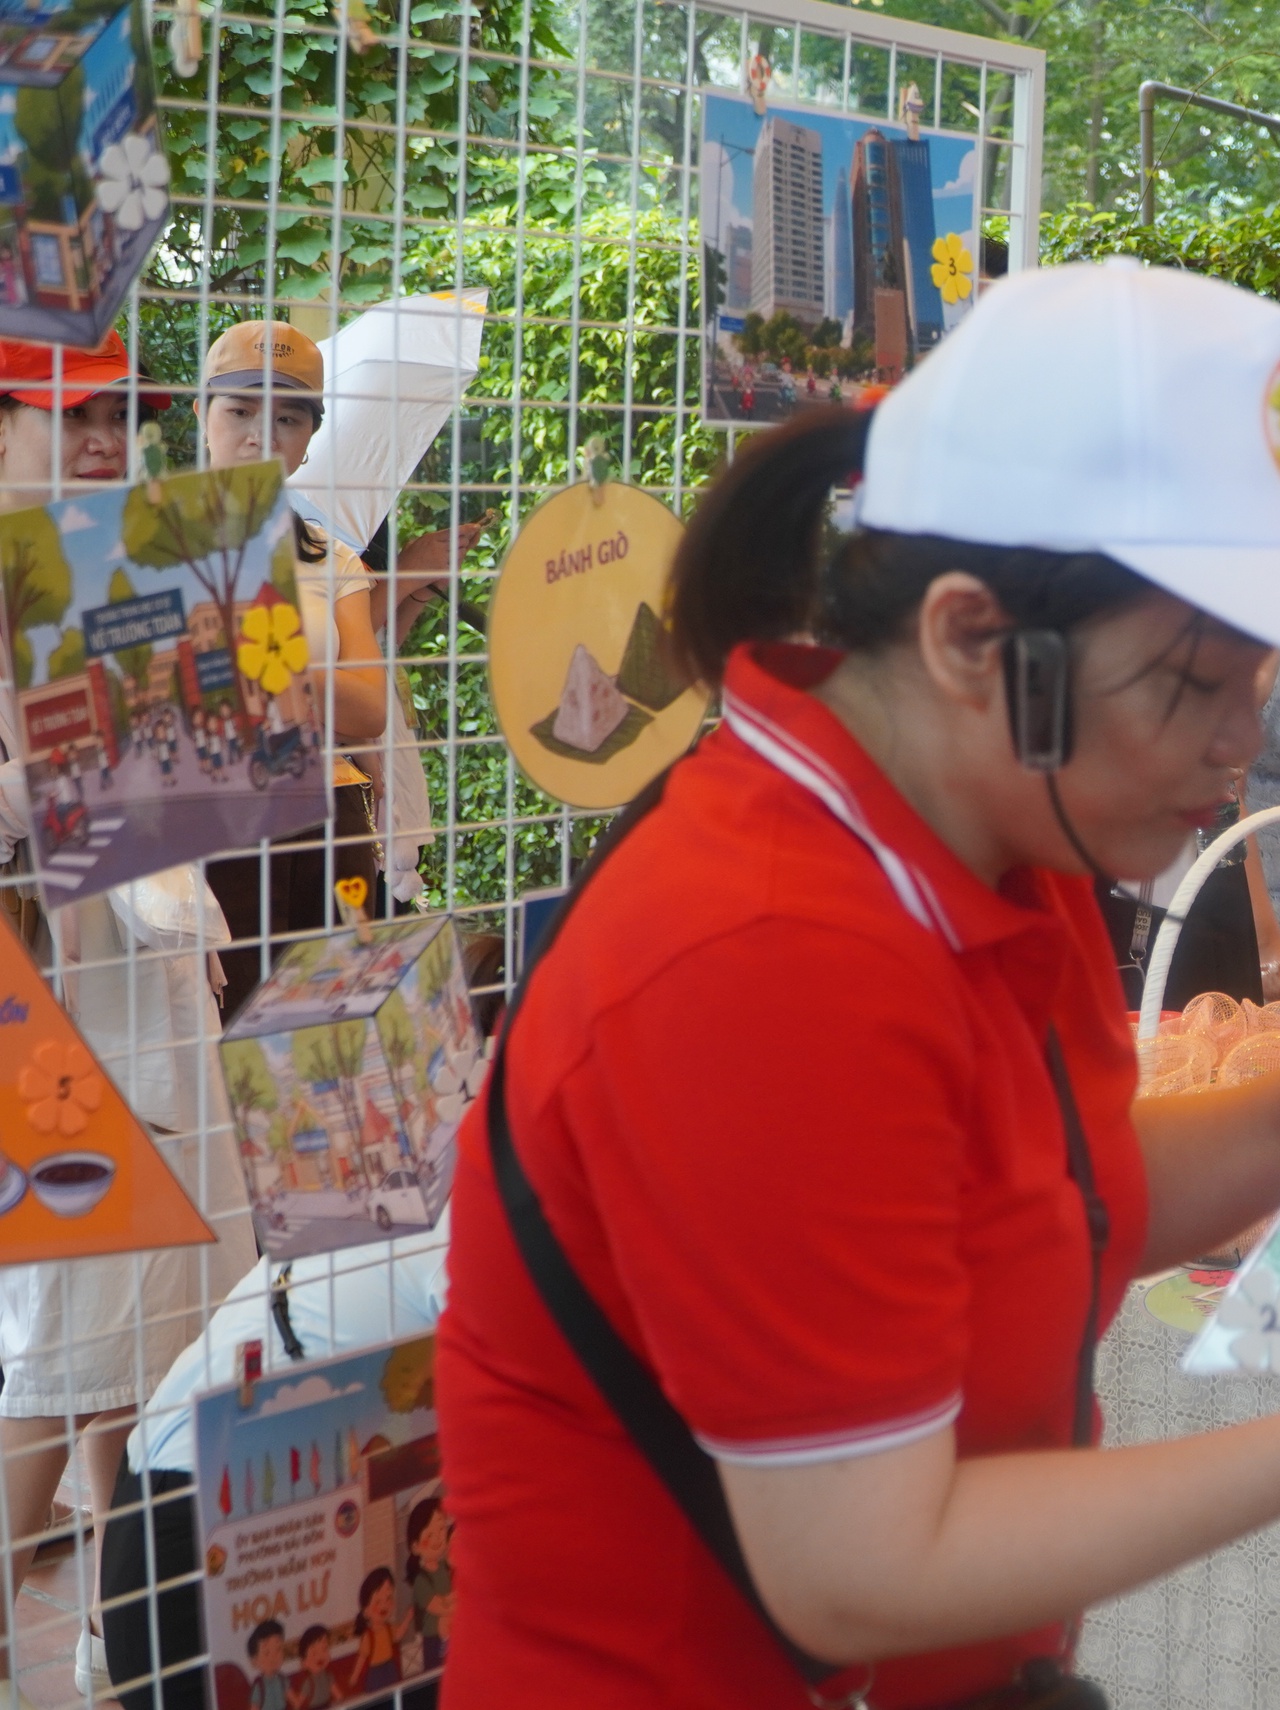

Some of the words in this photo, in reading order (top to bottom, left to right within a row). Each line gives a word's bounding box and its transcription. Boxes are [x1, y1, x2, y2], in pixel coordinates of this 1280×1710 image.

[948, 257, 957, 276] 3
[545, 544, 593, 584] BÁNH
[597, 530, 629, 566] GIÒ
[57, 1075, 72, 1101] 5
[458, 1079, 477, 1105] 1
[232, 1590, 290, 1632] HOA
[298, 1569, 331, 1612] LƯ
